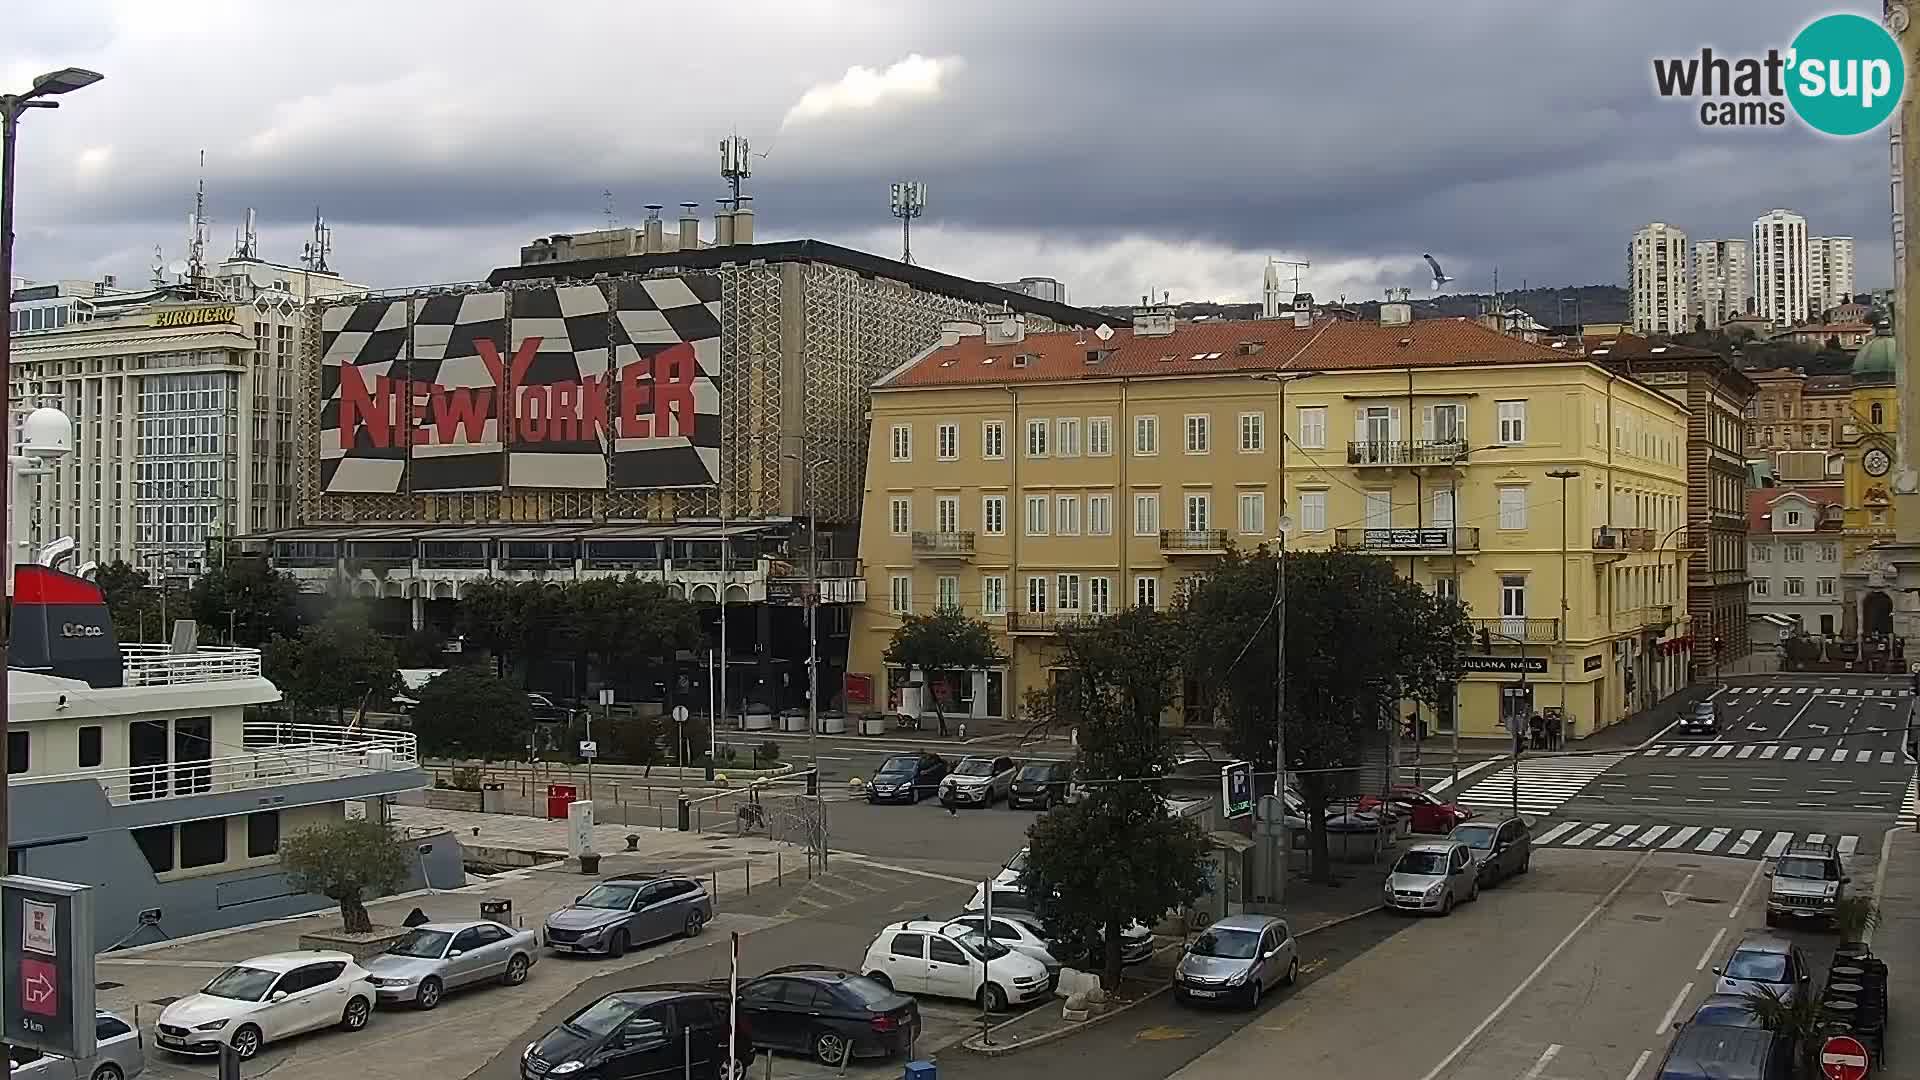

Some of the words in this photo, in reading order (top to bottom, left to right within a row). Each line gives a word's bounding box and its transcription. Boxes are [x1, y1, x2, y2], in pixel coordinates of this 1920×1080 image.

[1461, 660, 1506, 669] JULIANA
[1510, 660, 1543, 670] NAILS
[30, 1019, 44, 1033] km
